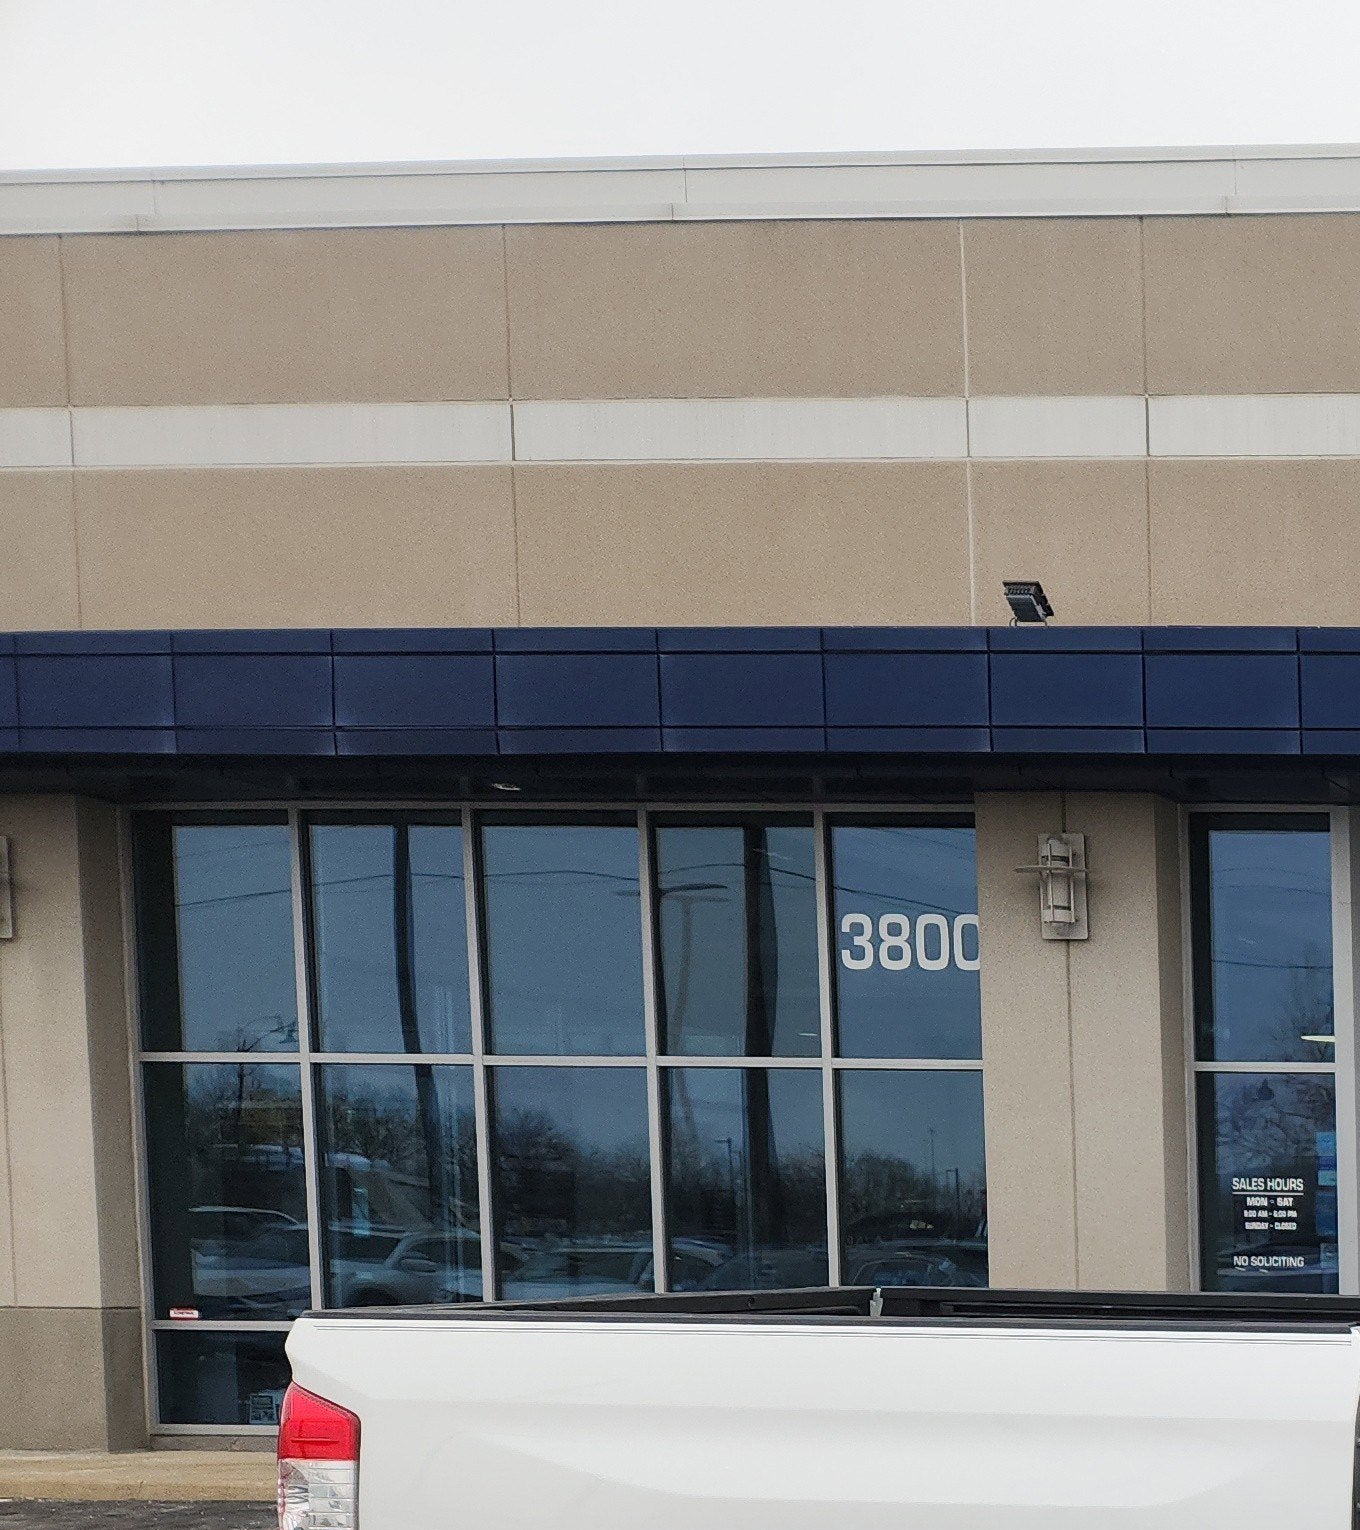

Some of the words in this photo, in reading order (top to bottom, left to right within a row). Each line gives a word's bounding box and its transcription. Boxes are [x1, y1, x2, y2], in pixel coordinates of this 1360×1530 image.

[841, 912, 981, 971] 3800
[1232, 1177, 1265, 1191] SALES
[1266, 1178, 1304, 1191] HOURS
[1233, 1255, 1249, 1267] NO
